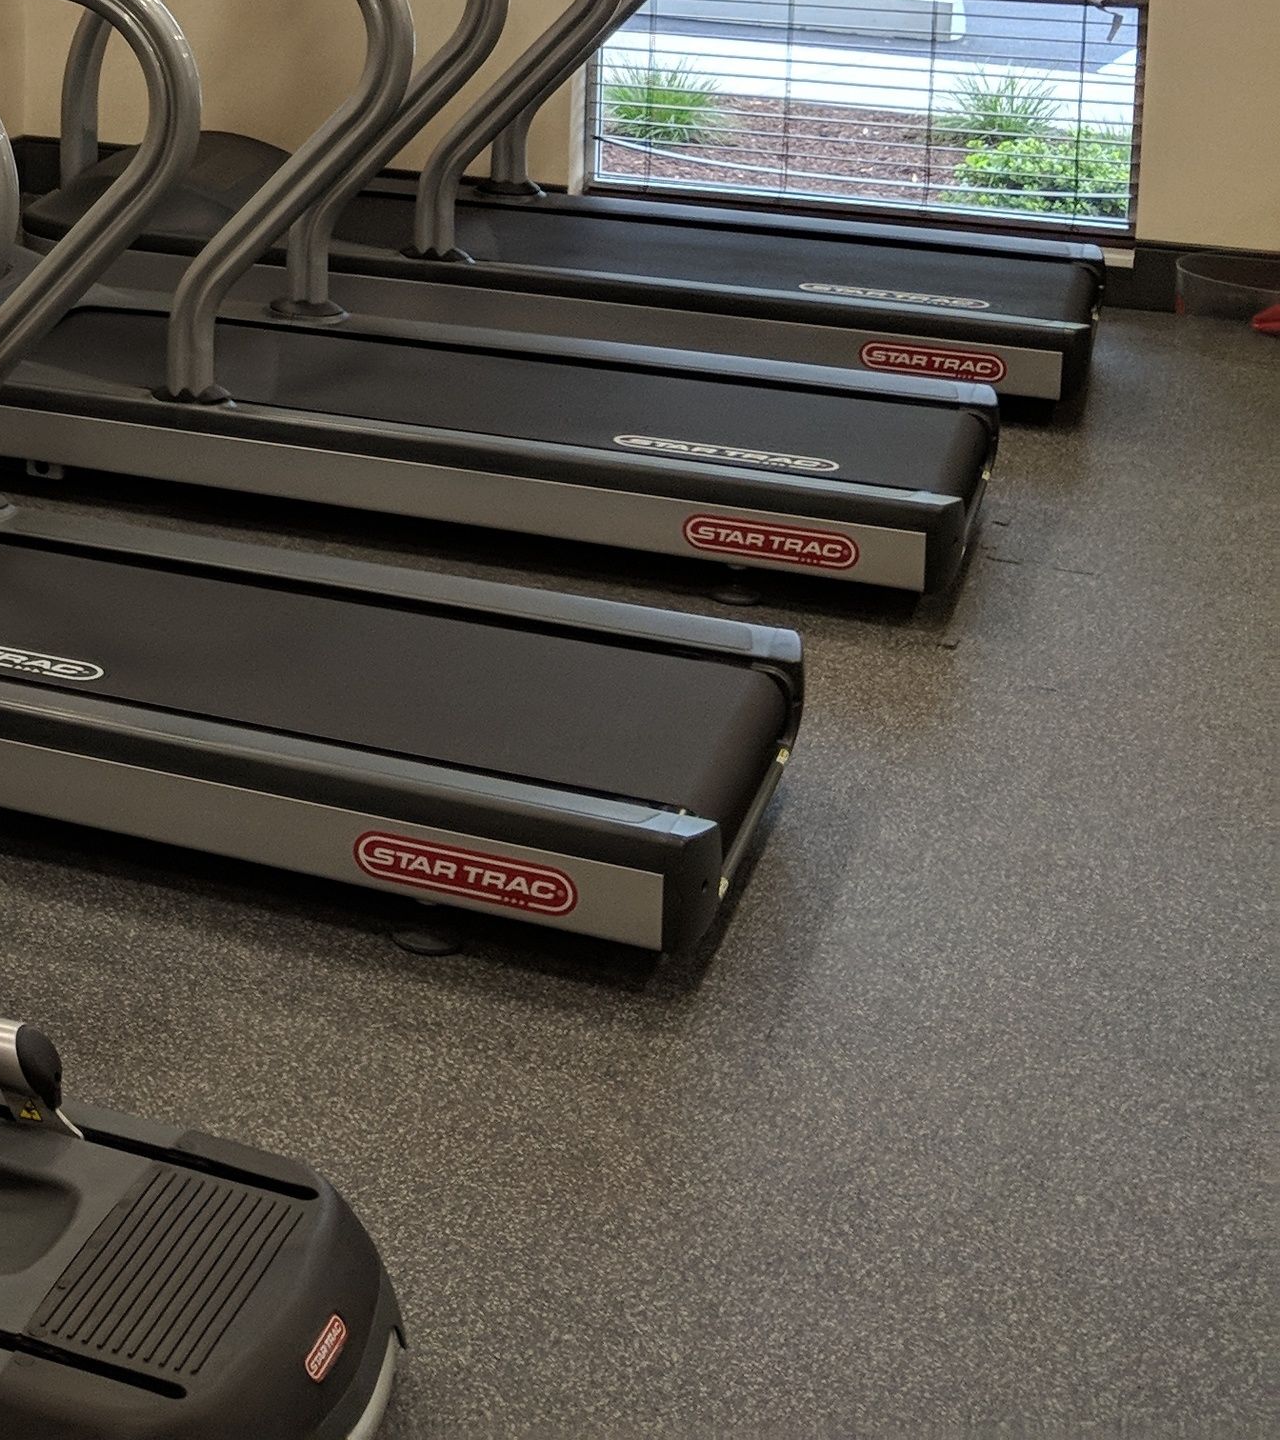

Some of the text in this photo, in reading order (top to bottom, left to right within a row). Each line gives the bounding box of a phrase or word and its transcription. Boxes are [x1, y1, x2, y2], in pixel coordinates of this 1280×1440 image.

[871, 350, 994, 374] STAR TRAC
[630, 438, 823, 468] STAR TRAC
[696, 526, 843, 559] STAR TRAC
[370, 847, 557, 900] STAR TRAC
[309, 1344, 328, 1373] STAR
